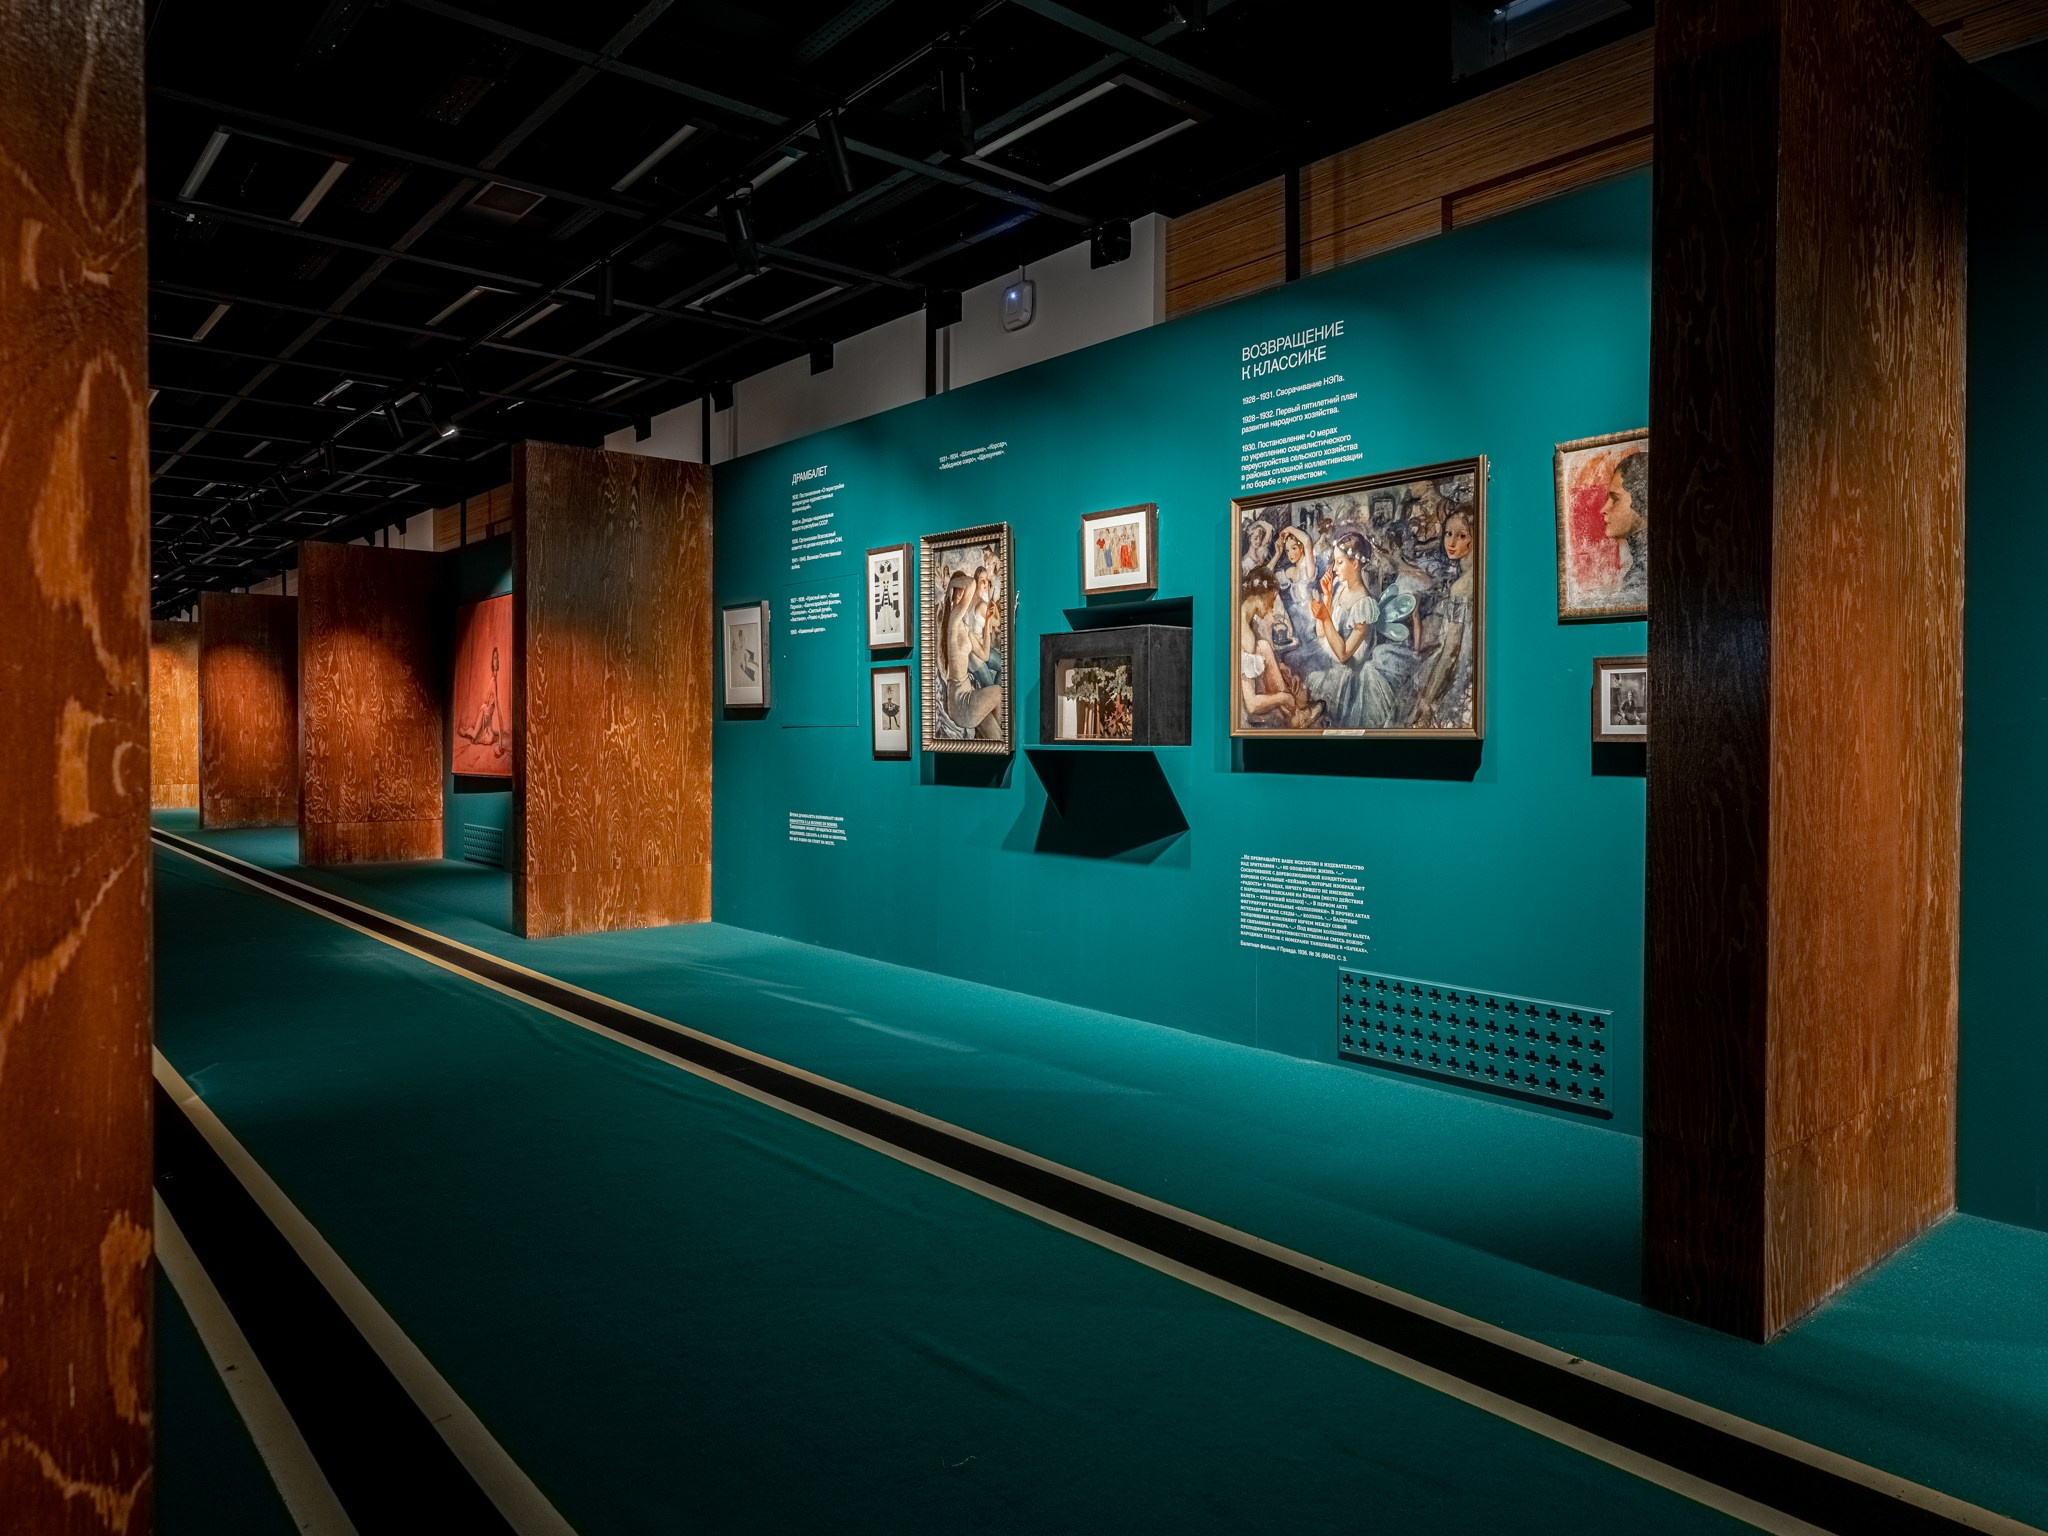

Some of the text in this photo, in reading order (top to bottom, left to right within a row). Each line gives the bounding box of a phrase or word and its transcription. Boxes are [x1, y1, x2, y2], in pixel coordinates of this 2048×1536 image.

[1242, 320, 1344, 361] ВОЗВРАЩЕНИЕ
[1242, 345, 1326, 380] К КЛАССИКЕ
[1276, 380, 1322, 397] Сворачивание
[1323, 374, 1344, 385] НЭПа.
[1276, 403, 1301, 416] Первый
[1301, 394, 1340, 410] пятилетний
[1340, 392, 1358, 402] план
[1241, 407, 1339, 435] развития народного хозяйства.
[1242, 443, 1257, 452] 1930.
[1258, 434, 1306, 449] Постановление
[1316, 427, 1338, 437] мерах
[1249, 447, 1287, 462] укреплению
[1287, 434, 1351, 453] социалистического
[1241, 443, 1358, 472] переустройства сельского хозяйства
[1246, 470, 1271, 482] районах
[1271, 462, 1303, 478] сплошной
[1304, 453, 1363, 469] коллективизации
[792, 465, 828, 486] ДРАМБАЛЕТ
[1246, 480, 1254, 489] по
[1254, 477, 1276, 488] борьбе
